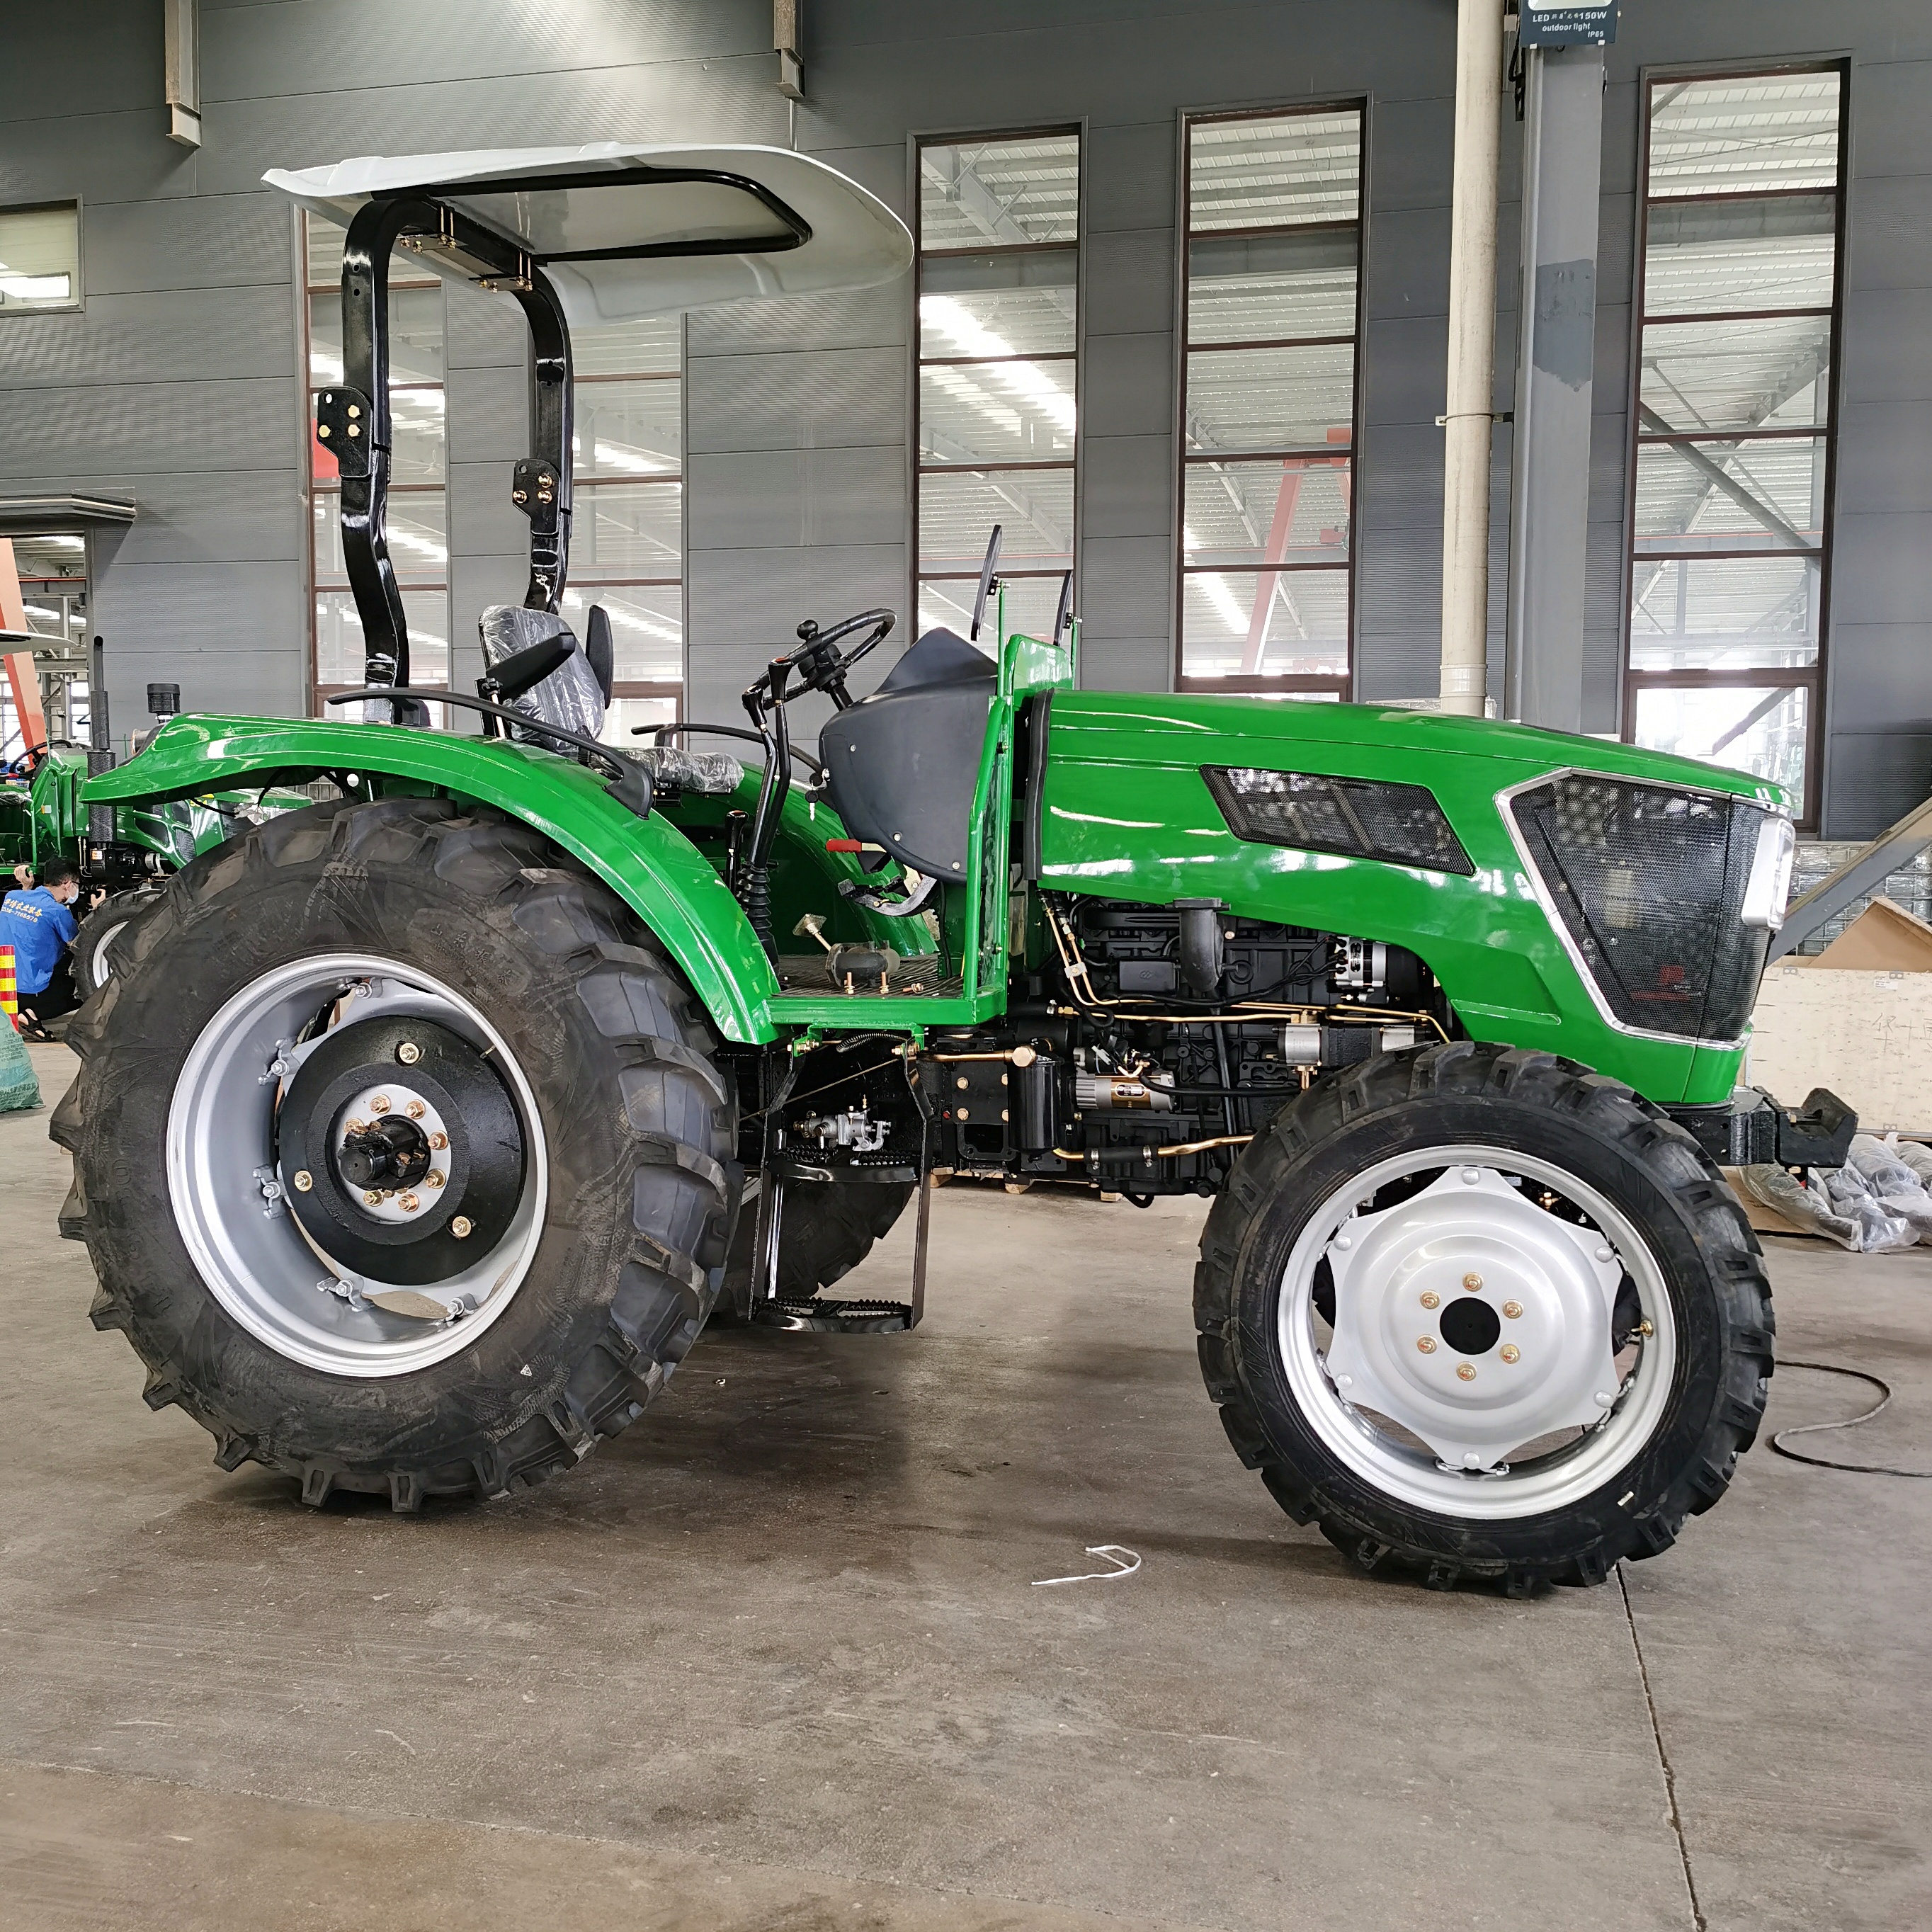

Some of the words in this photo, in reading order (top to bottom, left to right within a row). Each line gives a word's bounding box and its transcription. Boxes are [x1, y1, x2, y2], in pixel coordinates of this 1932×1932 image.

[1579, 11, 1607, 20] 150W
[1542, 23, 1572, 32] outdoor
[1573, 22, 1591, 32] light
